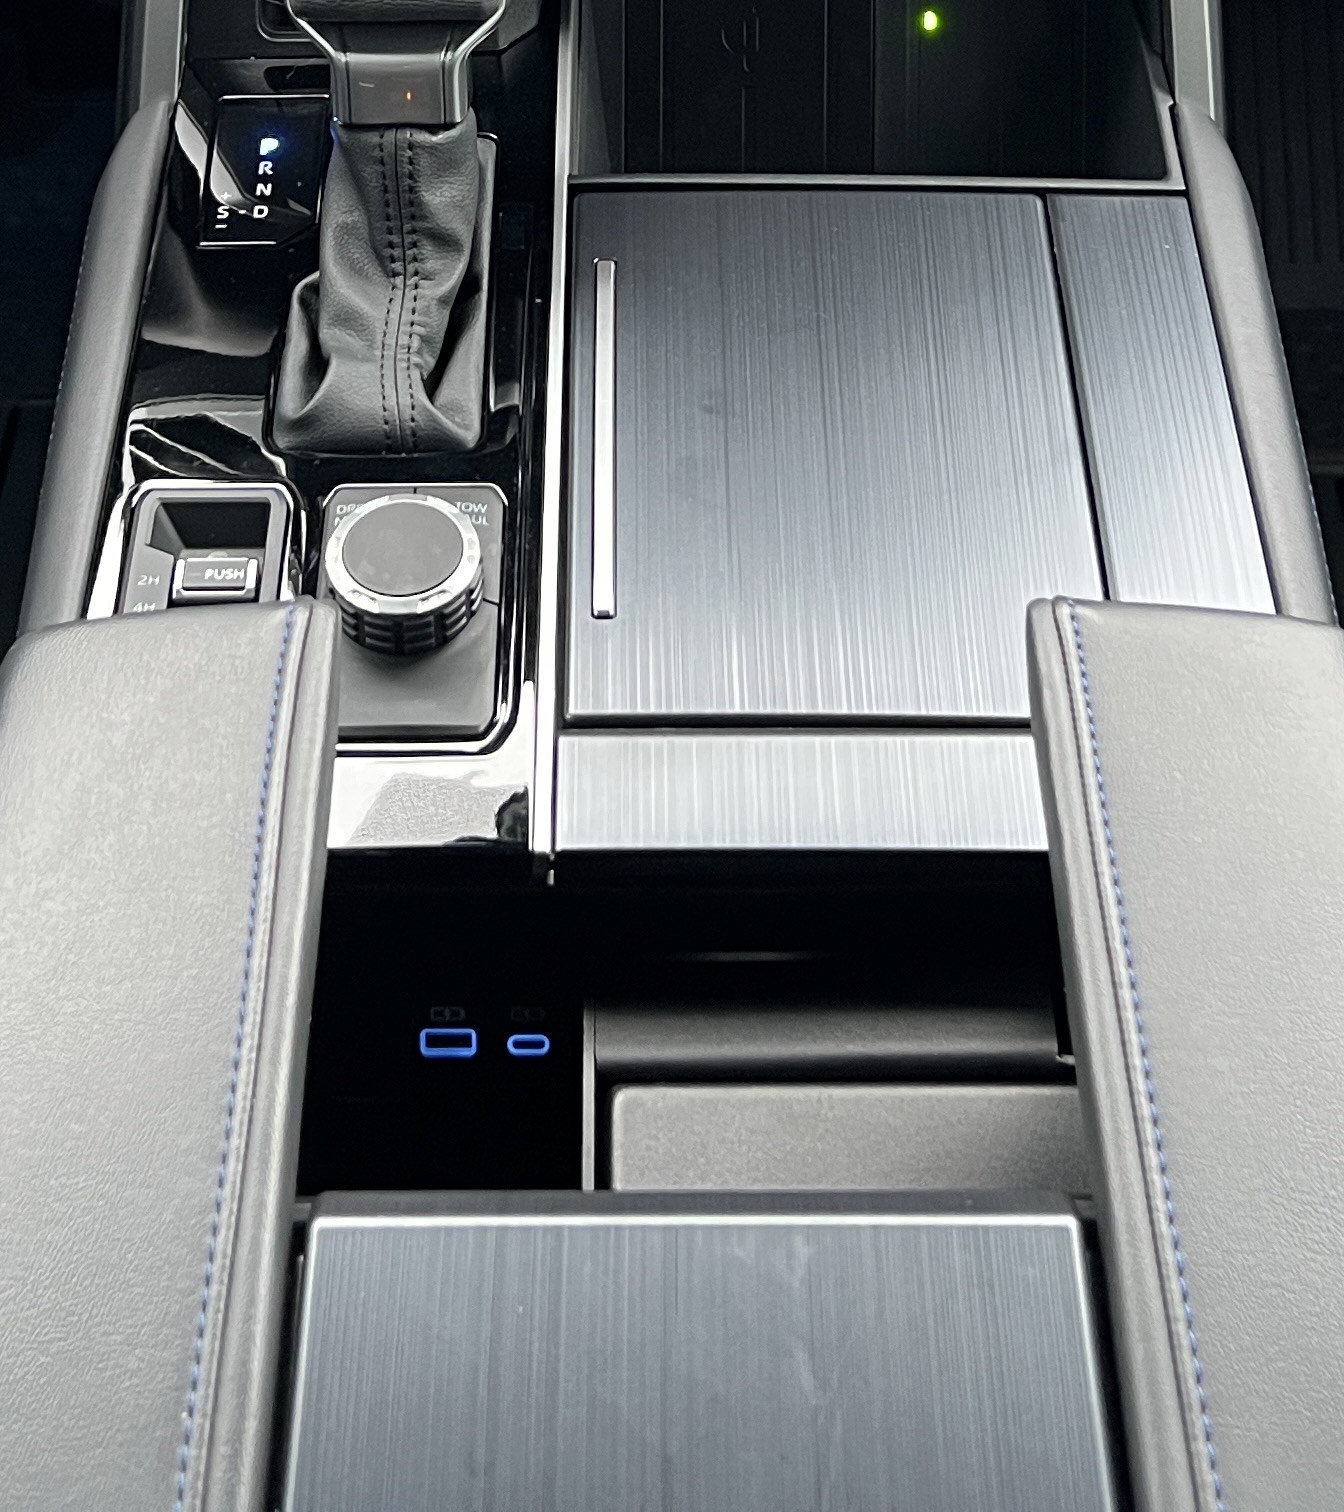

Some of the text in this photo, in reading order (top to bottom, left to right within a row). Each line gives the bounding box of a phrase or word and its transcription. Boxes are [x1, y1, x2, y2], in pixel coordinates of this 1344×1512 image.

[259, 137, 279, 156] P
[258, 161, 273, 175] R
[256, 183, 272, 196] N
[217, 205, 269, 219] S D
[137, 574, 160, 586] 2H
[204, 568, 245, 580] PUSH
